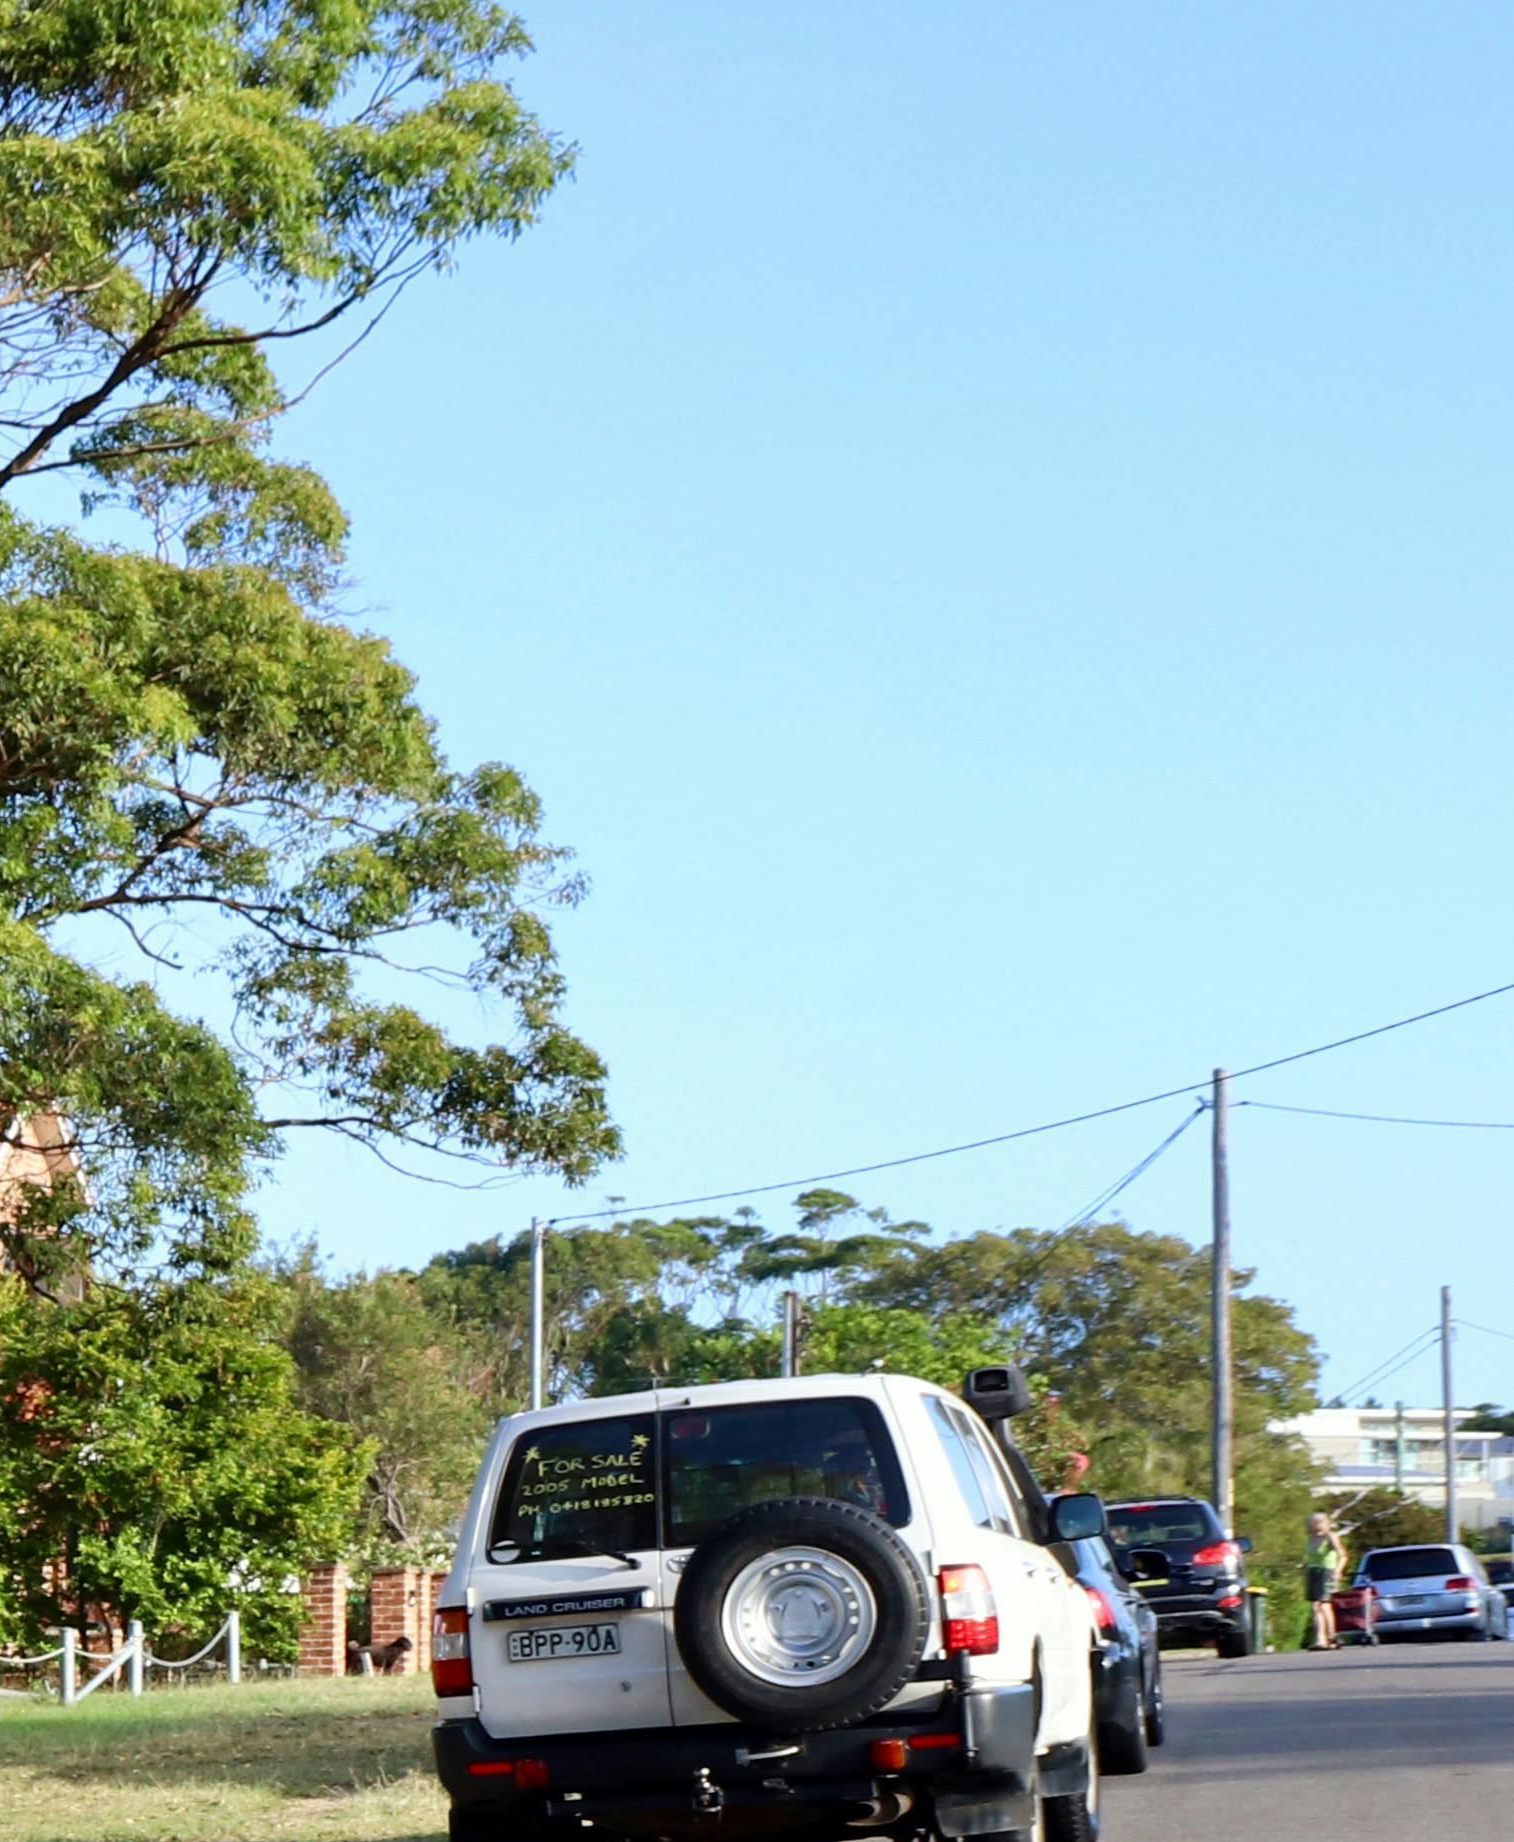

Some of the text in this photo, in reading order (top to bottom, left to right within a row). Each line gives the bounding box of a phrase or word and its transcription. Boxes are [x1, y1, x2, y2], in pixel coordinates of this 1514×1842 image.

[538, 1452, 642, 1477] FOR SALE
[521, 1473, 644, 1496] 2005 MODEL
[505, 1598, 625, 1617] LAND CRUISER
